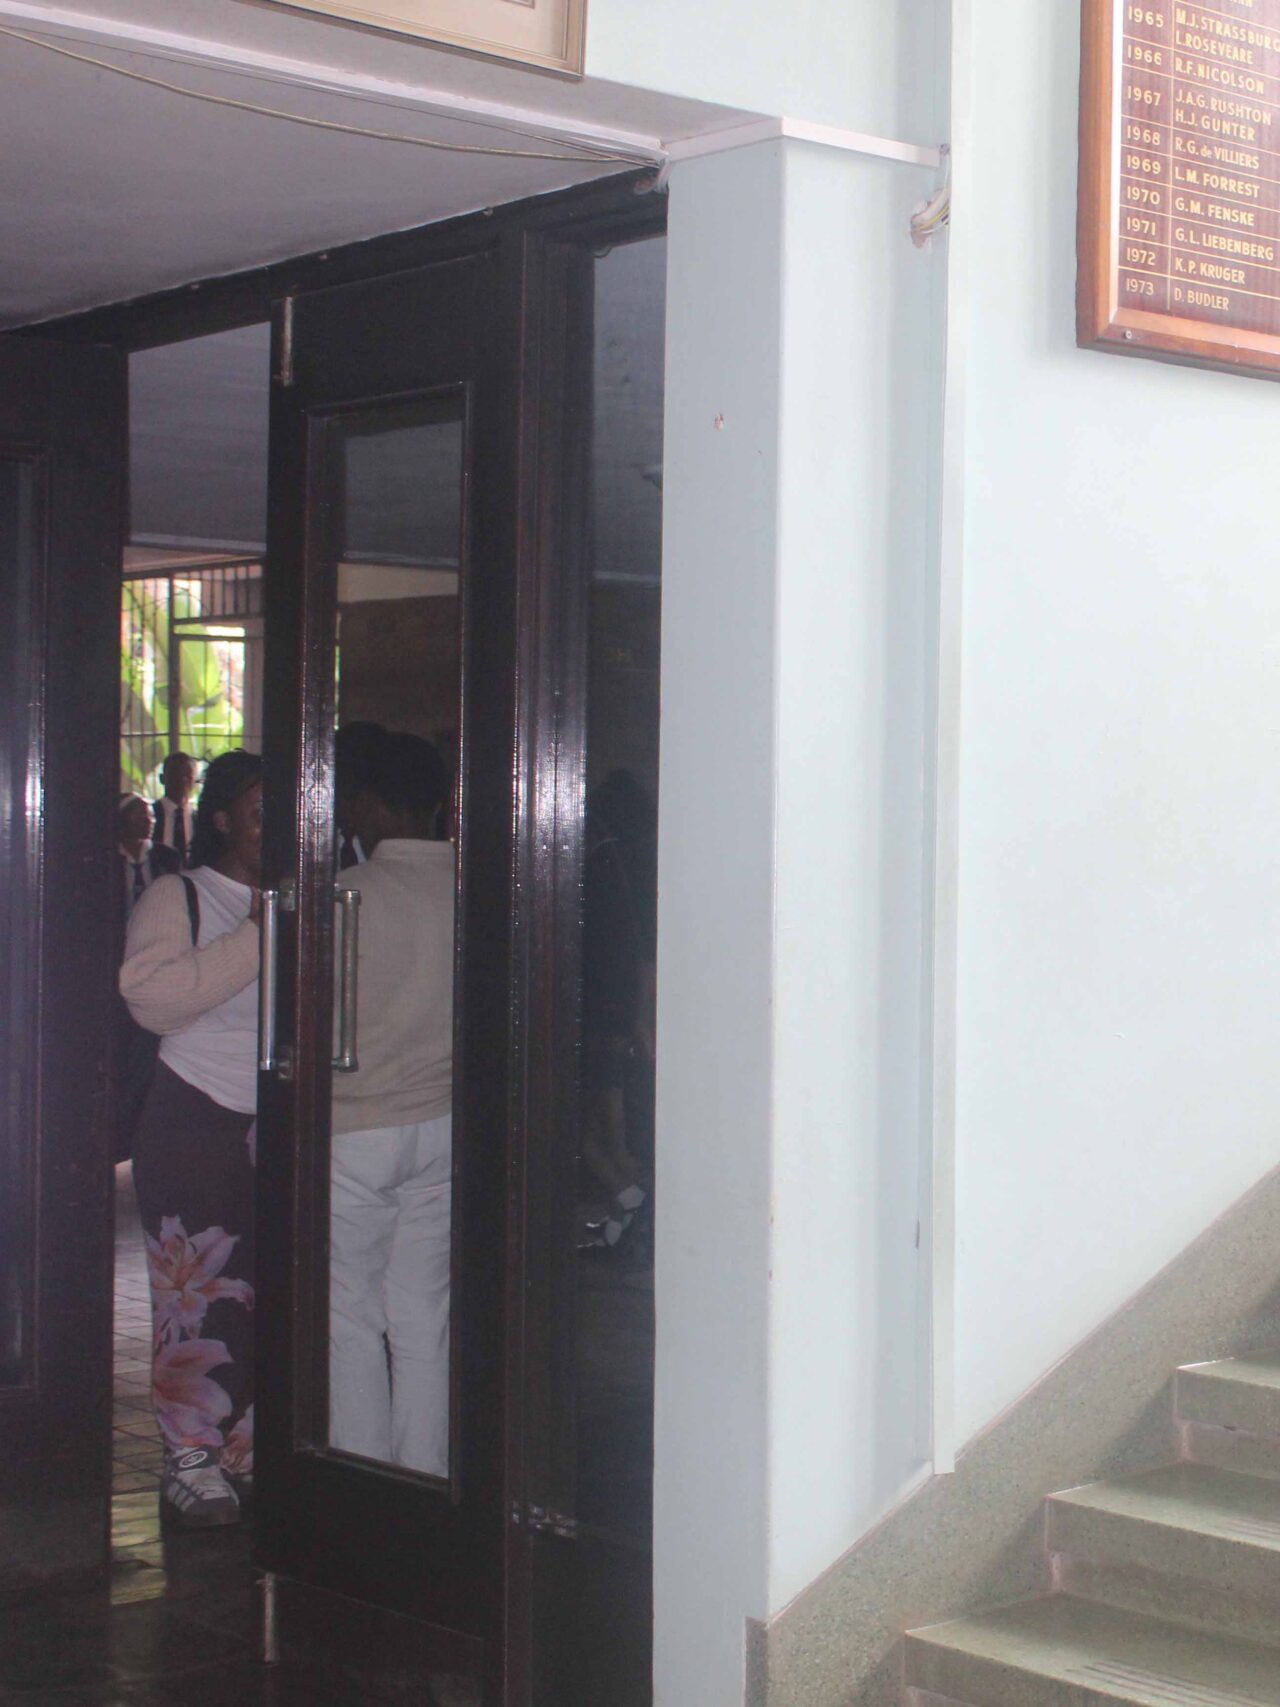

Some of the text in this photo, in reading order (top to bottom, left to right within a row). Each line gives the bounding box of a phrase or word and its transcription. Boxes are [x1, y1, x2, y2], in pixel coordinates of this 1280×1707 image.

[1128, 5, 1164, 28] 1965
[1127, 45, 1163, 66] 1966
[1127, 85, 1161, 106] 1967
[1127, 125, 1161, 146] 1968
[1201, 114, 1256, 141] GUNTER
[1127, 155, 1161, 175] 1969
[1203, 173, 1261, 199] FORREST
[1127, 186, 1161, 206] 1970
[1208, 204, 1256, 227] FENSKE
[1127, 217, 1156, 236] 1971
[1202, 233, 1275, 261] LIEBENBERG
[1126, 247, 1156, 267] 1972
[1199, 262, 1246, 285] KRUGER
[1126, 278, 1155, 296] 1973
[1187, 290, 1230, 312] BUDLER
